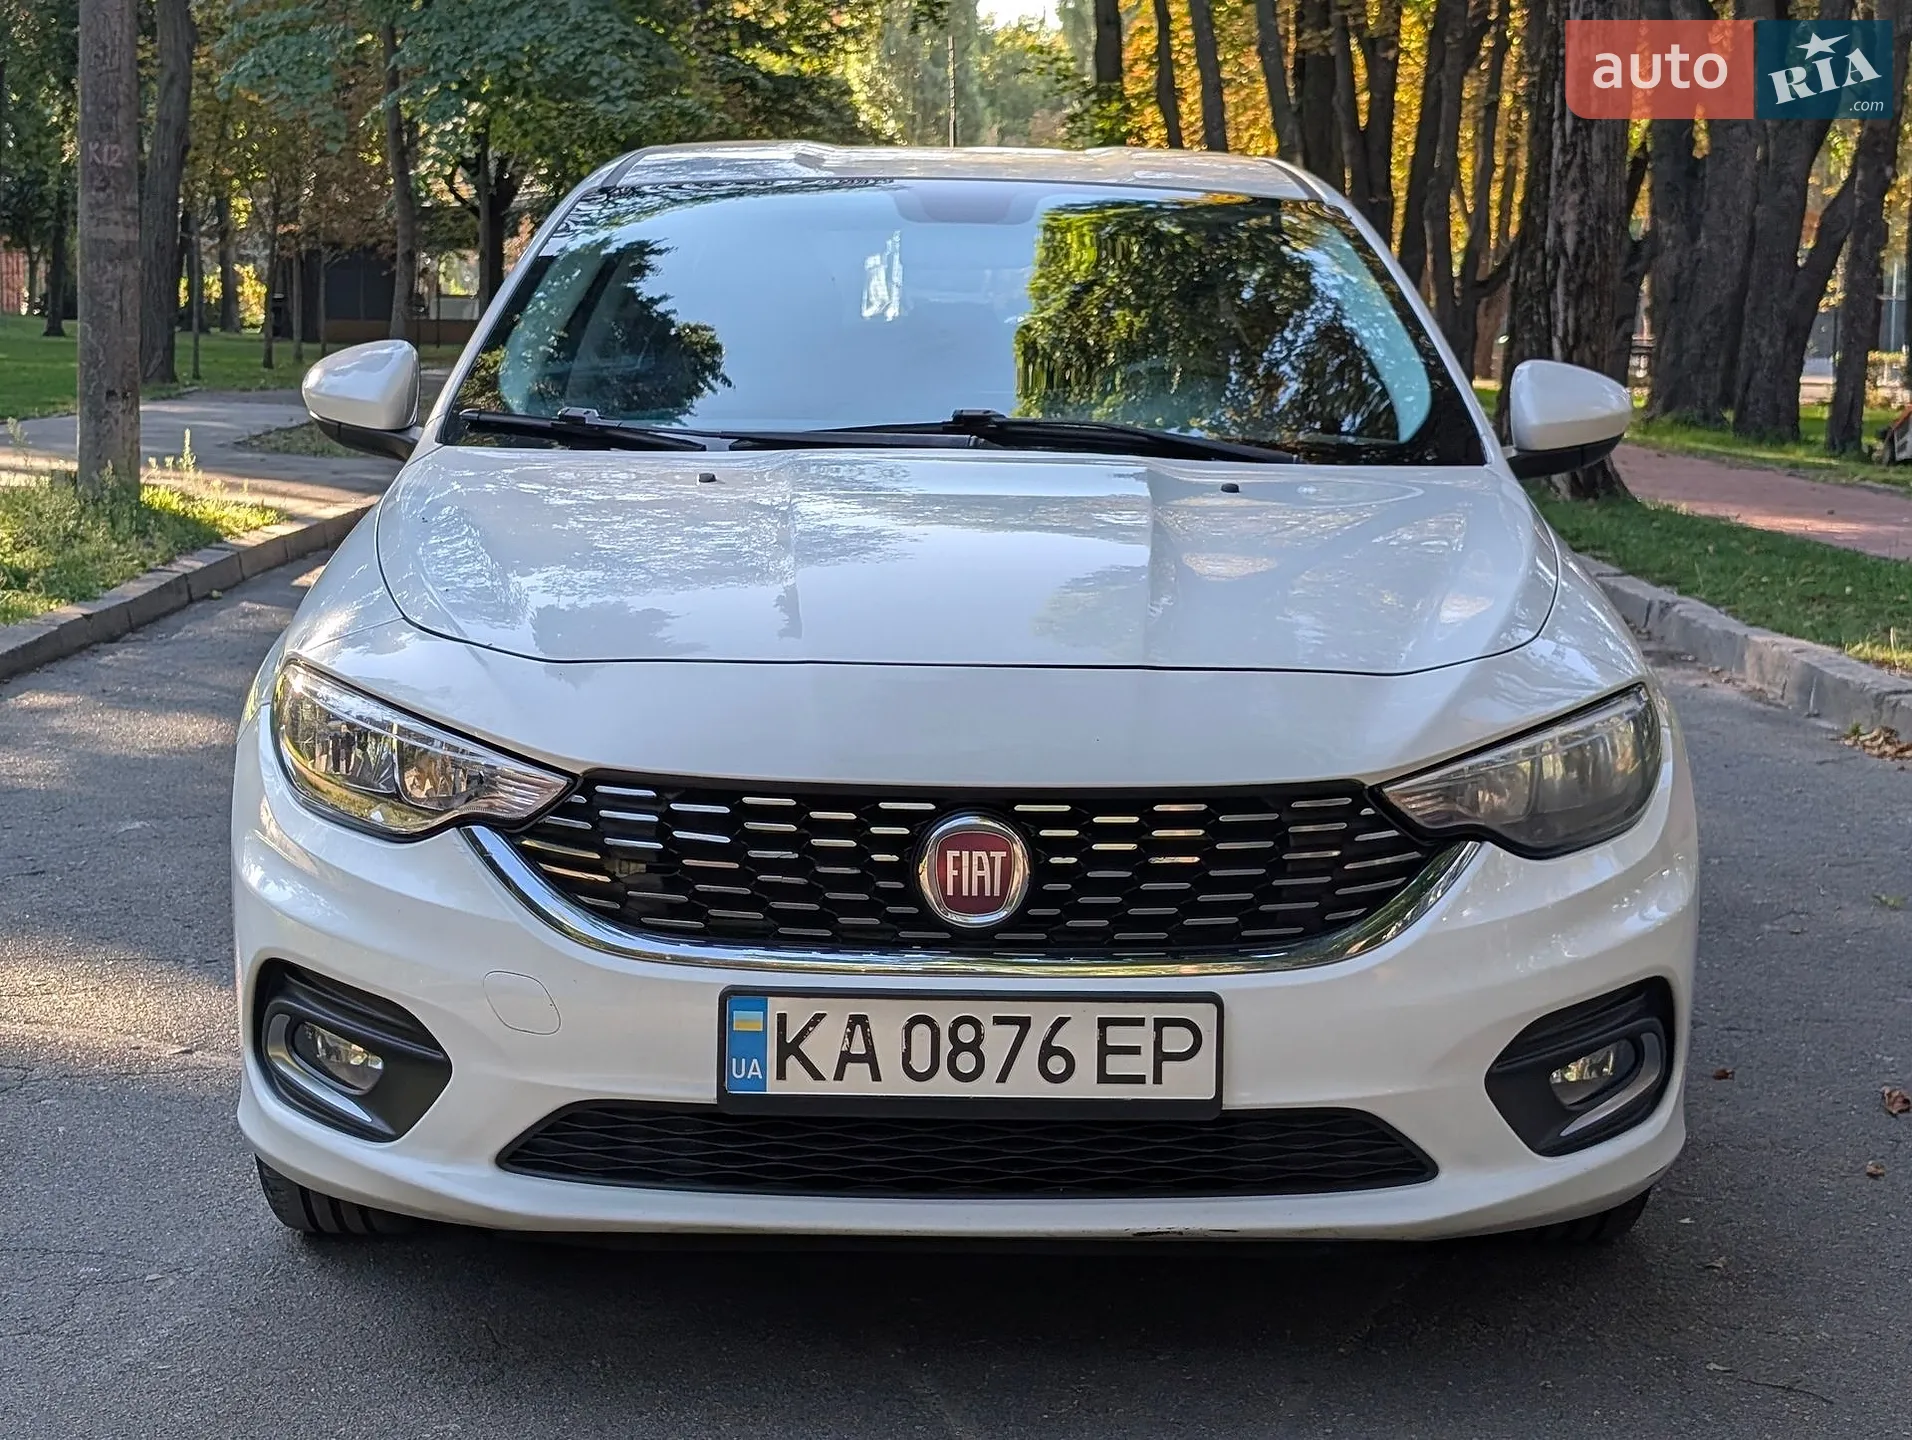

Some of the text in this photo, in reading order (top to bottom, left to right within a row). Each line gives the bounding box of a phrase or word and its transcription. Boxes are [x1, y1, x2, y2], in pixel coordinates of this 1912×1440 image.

[946, 850, 1007, 897] FIAT
[731, 1058, 763, 1080] UA
[775, 1012, 1203, 1085] KA 0876 EP
